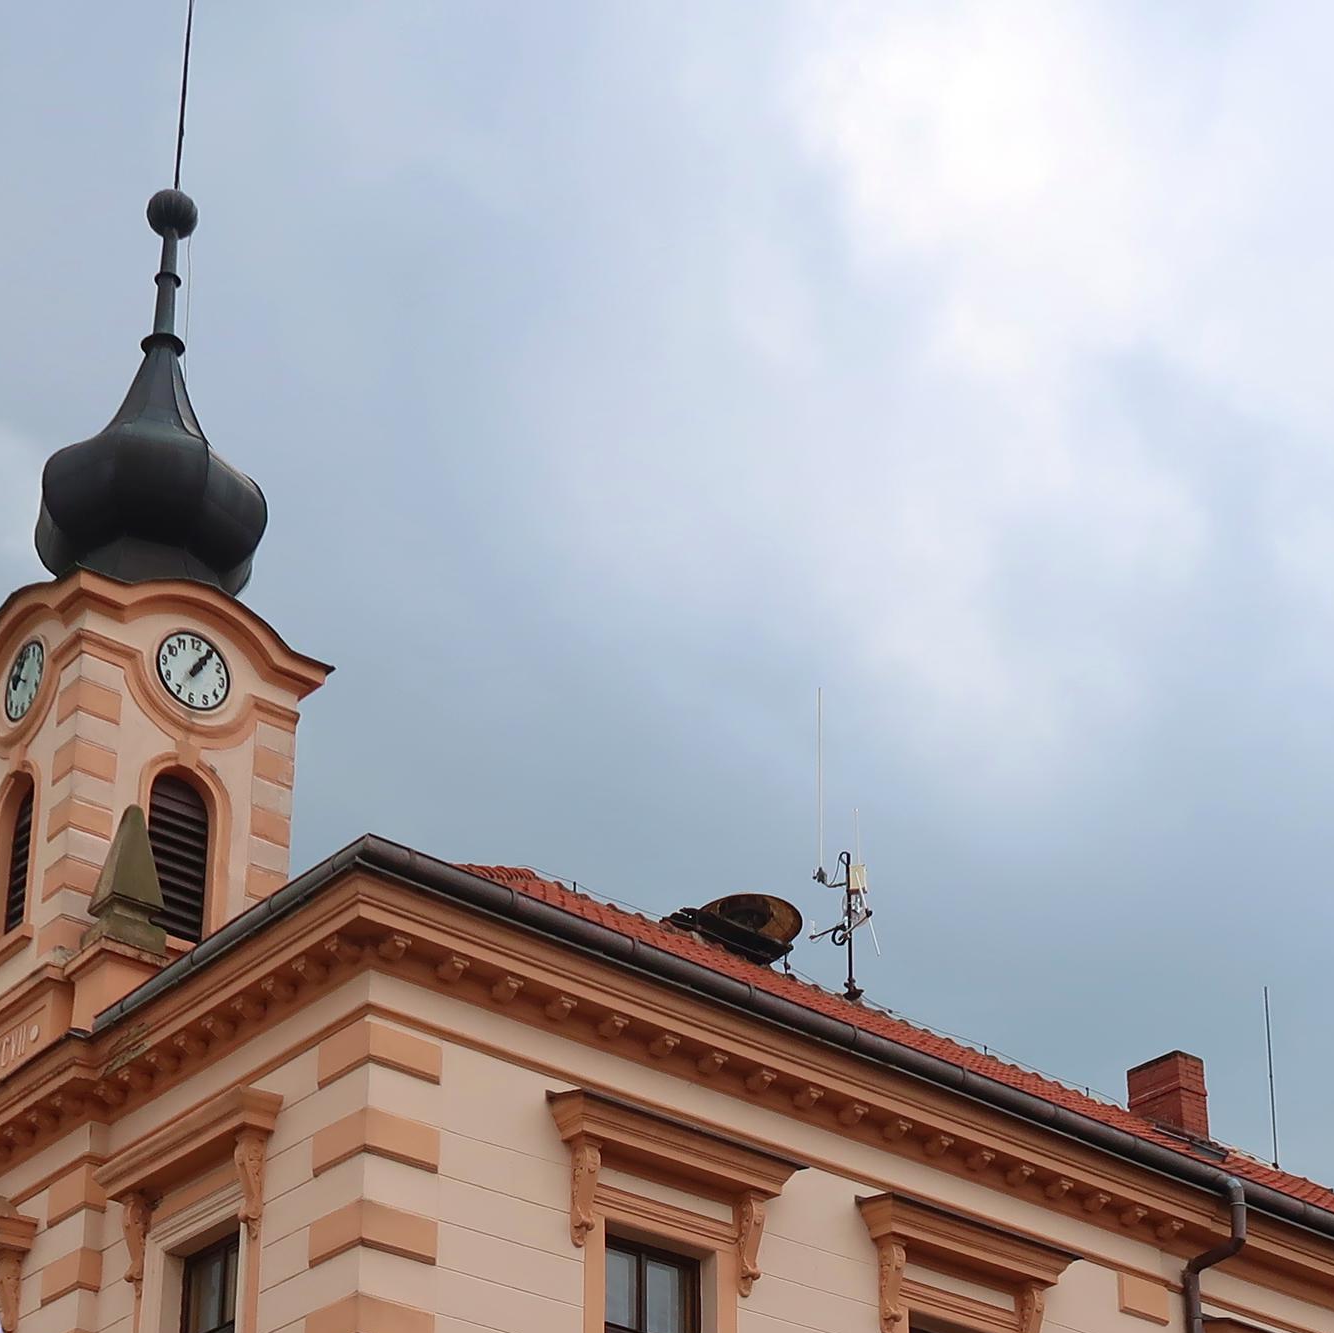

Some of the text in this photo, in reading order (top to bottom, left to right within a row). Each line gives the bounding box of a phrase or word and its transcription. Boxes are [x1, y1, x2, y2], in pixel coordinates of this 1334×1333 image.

[167, 644, 178, 657] 10
[190, 638, 202, 652] 12
[161, 654, 168, 665] 9
[215, 662, 222, 674] 2
[165, 669, 172, 681] 8
[218, 677, 225, 688] 3
[175, 683, 182, 695] 7
[188, 692, 195, 703] 6
[202, 694, 209, 706] 5
